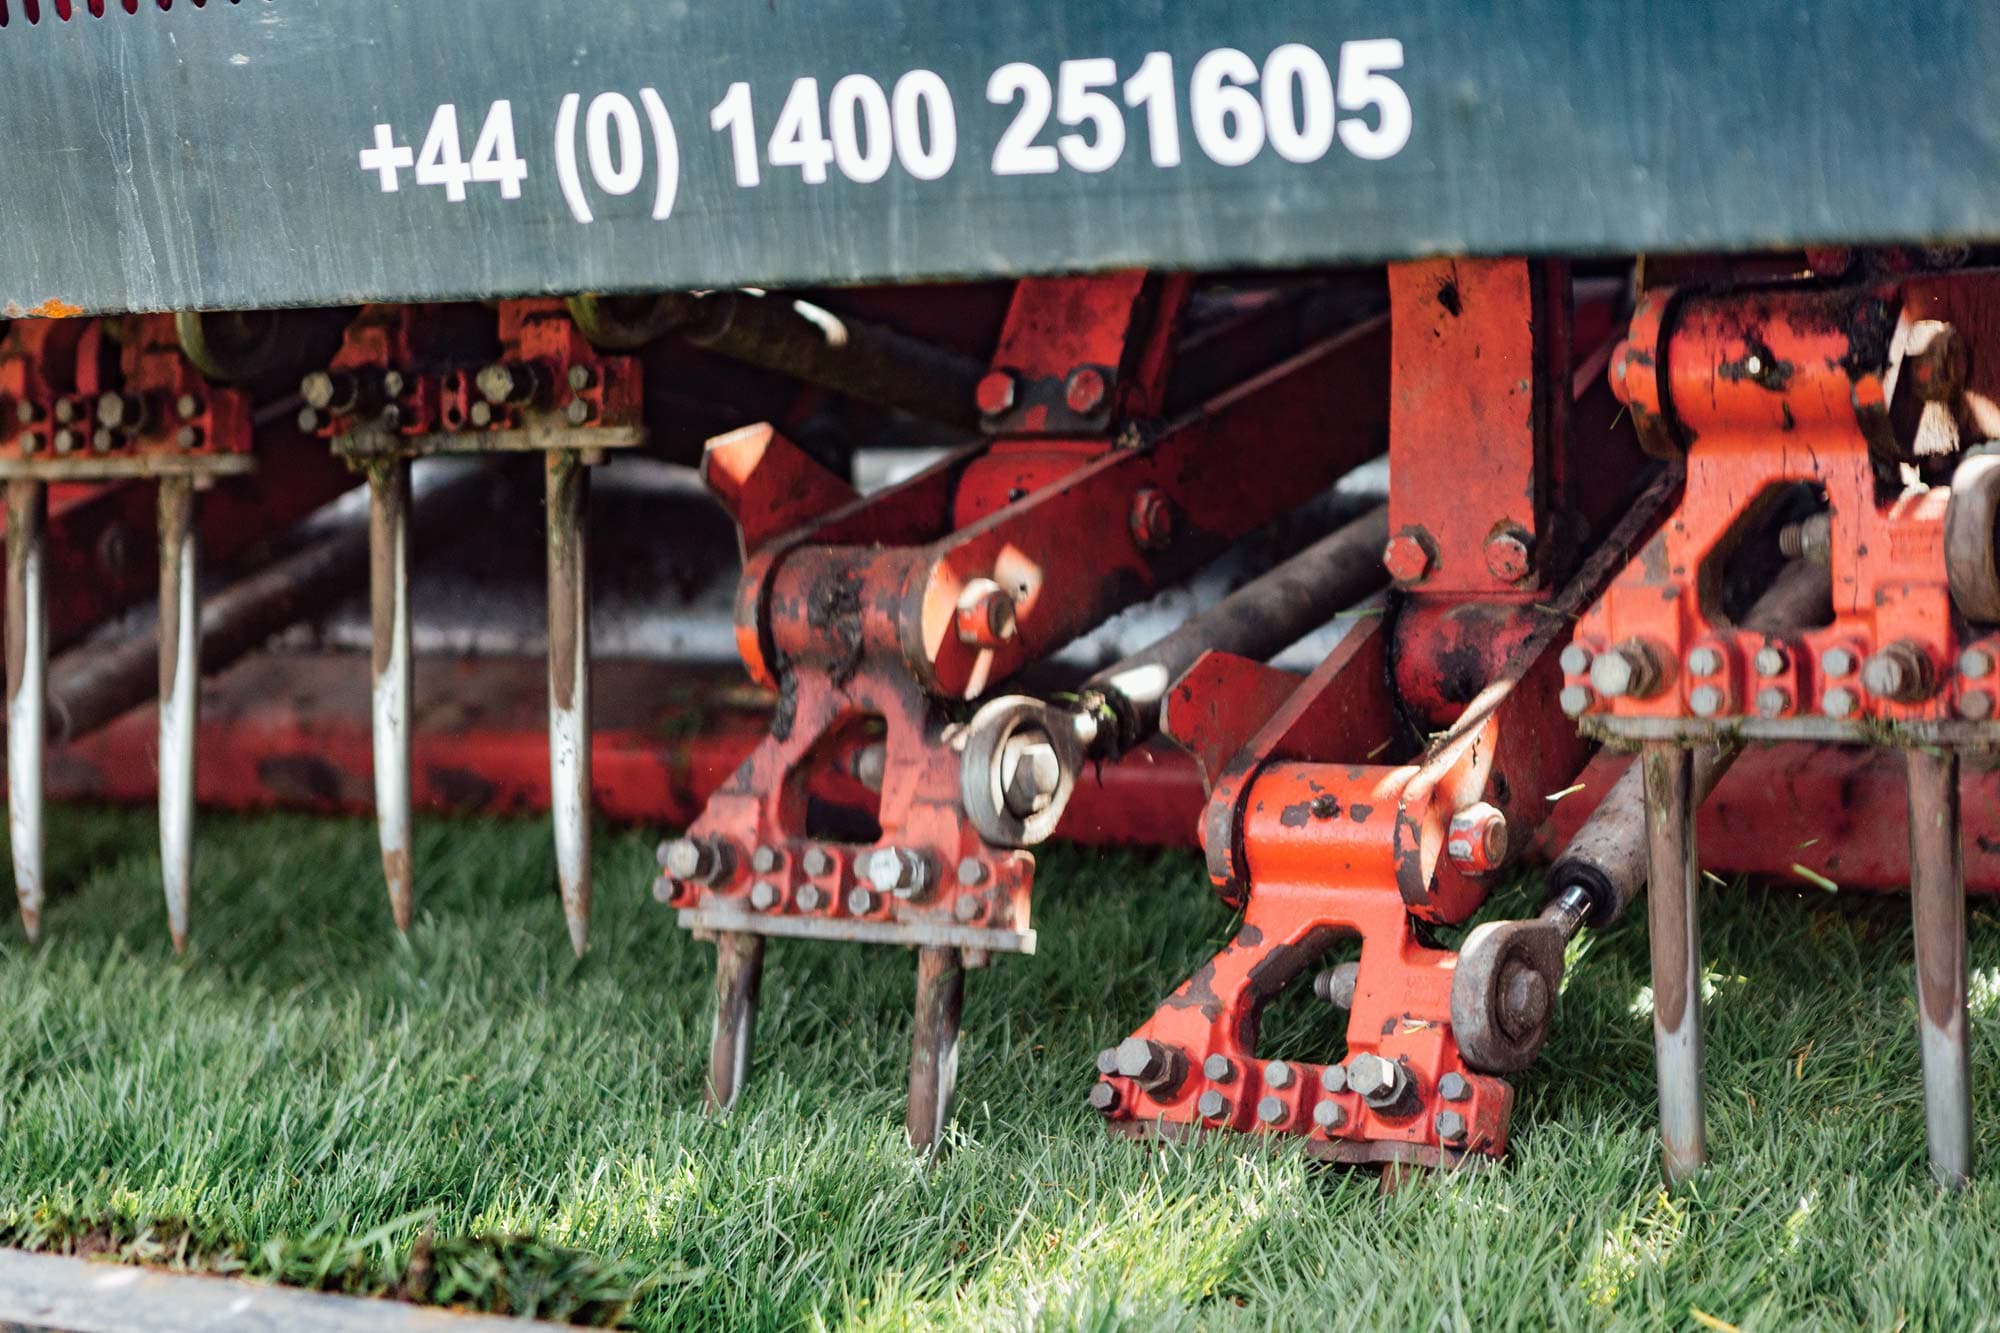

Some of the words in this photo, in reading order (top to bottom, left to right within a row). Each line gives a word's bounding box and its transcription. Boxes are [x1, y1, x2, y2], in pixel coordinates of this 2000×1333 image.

[358, 99, 528, 203] +44
[554, 87, 680, 224] (0)
[710, 69, 957, 187] 1400
[987, 38, 1413, 177] 251605
